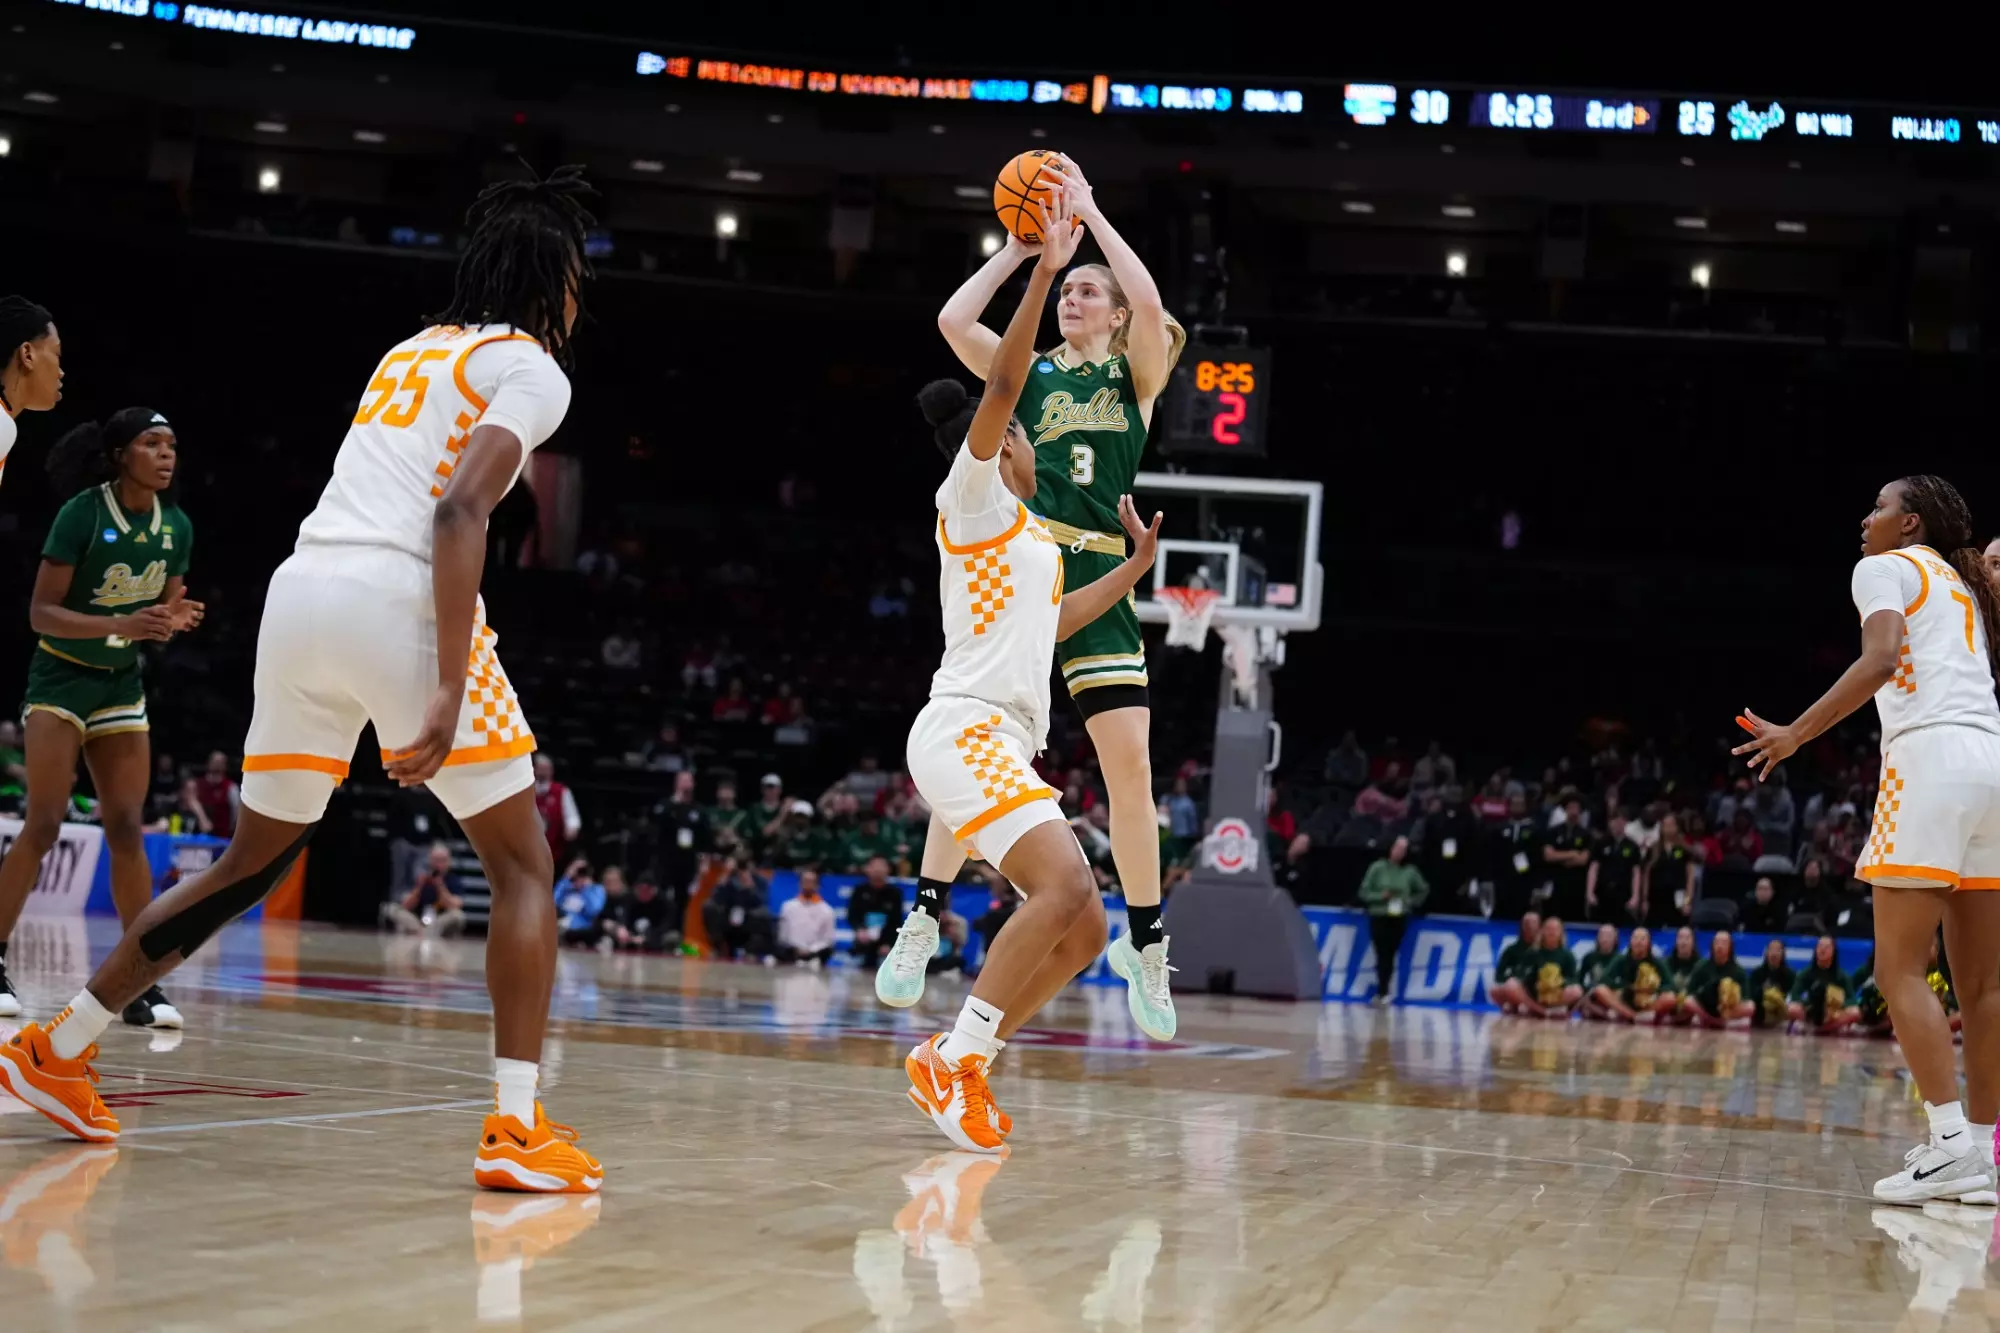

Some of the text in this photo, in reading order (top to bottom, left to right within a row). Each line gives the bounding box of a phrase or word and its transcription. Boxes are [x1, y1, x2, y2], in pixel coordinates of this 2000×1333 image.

[1410, 89, 1449, 124] 30
[1678, 101, 1715, 135] 25
[352, 349, 453, 428] 55
[1196, 361, 1255, 394] 8:25
[1034, 387, 1129, 446] Bulls
[1213, 394, 1246, 445] 2
[1071, 443, 1095, 486] 3
[1951, 590, 1976, 655] 7
